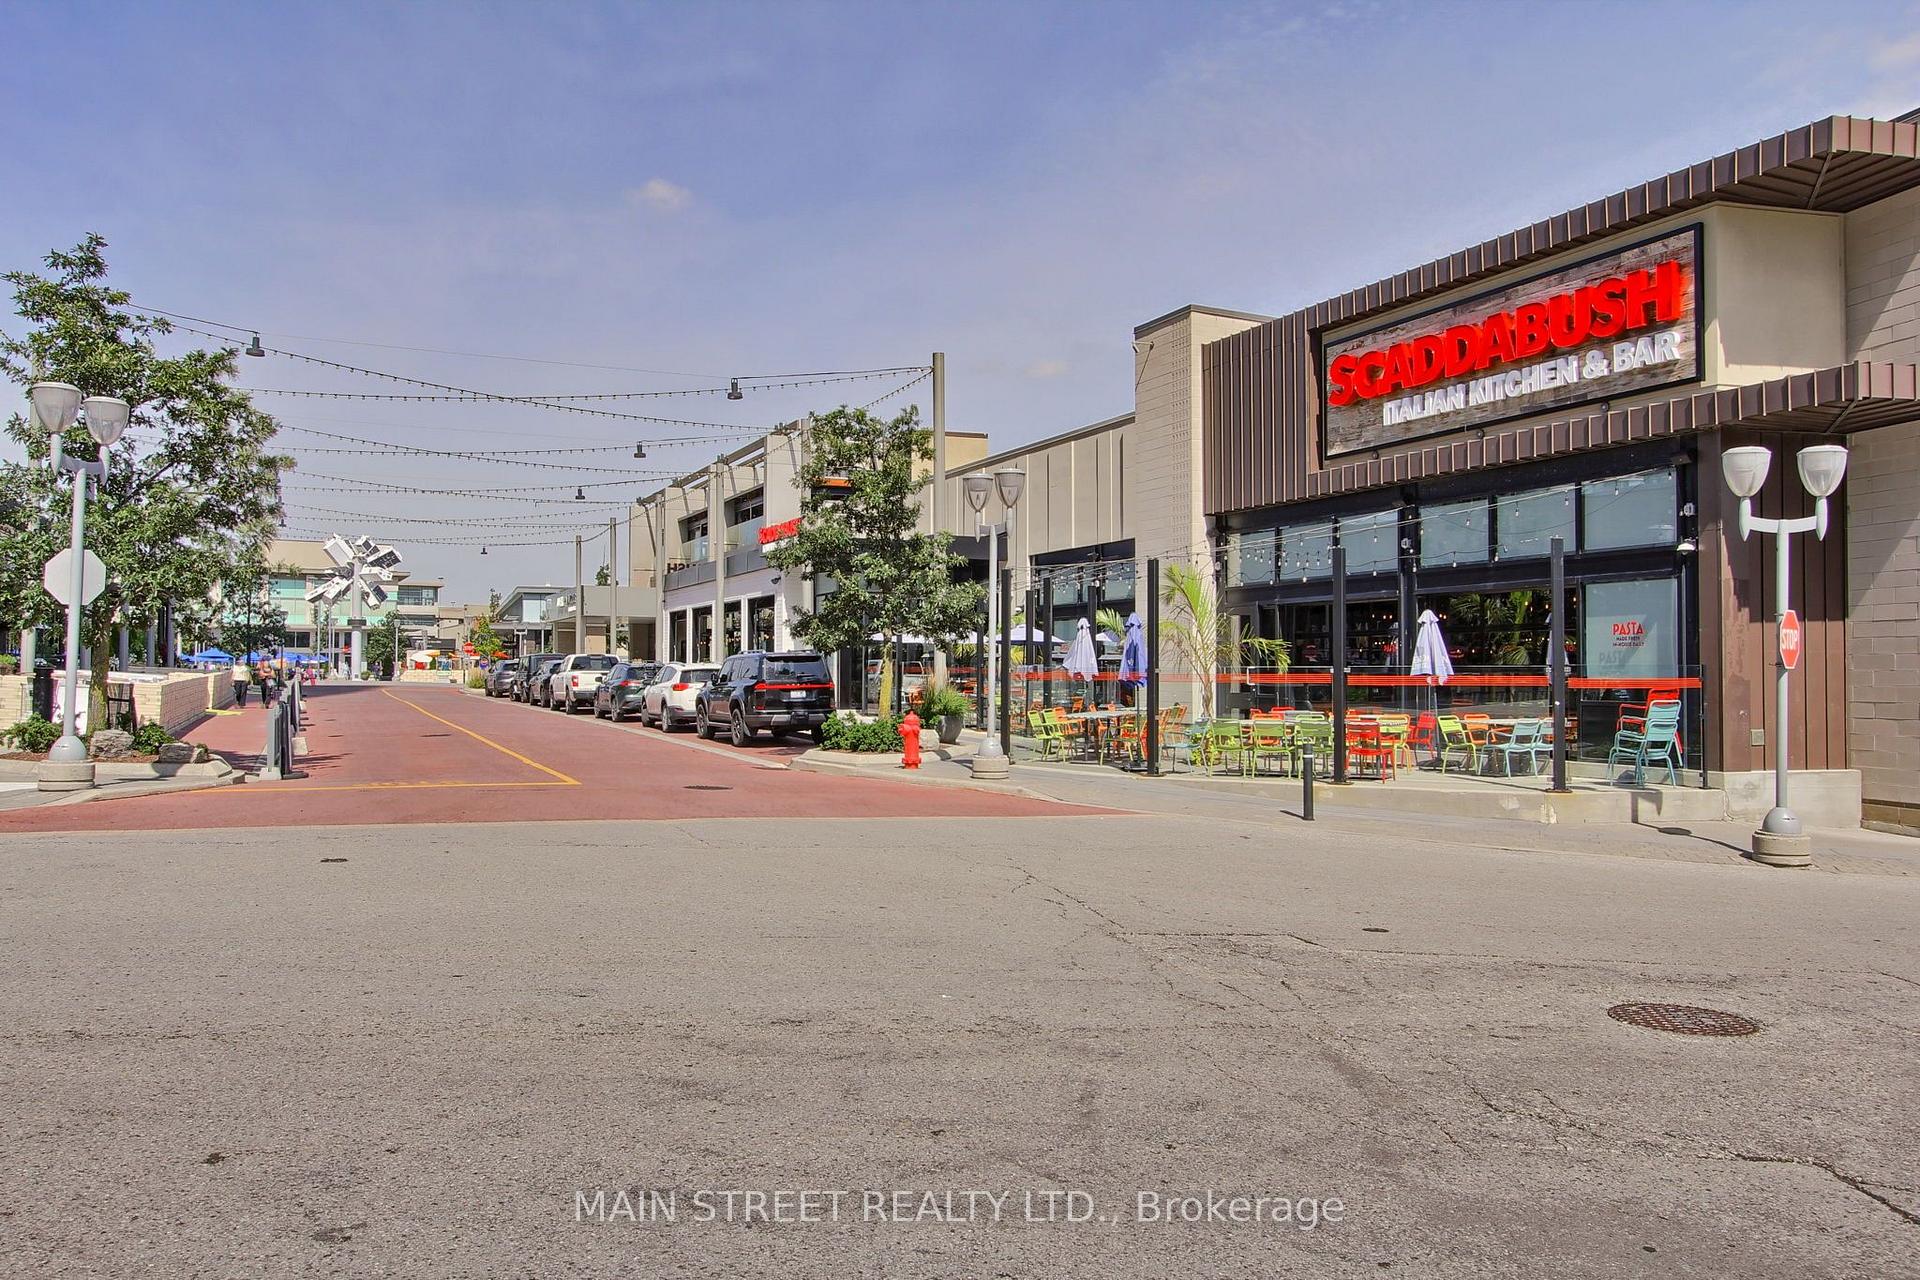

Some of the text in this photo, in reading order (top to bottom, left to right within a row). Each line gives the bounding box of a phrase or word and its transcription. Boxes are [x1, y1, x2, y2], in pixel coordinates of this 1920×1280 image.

[1328, 260, 1684, 407] SCADDABUSH
[1382, 331, 1682, 426] ITALIAN KITCHEN & BAR
[1613, 621, 1644, 635] PASTA
[1782, 629, 1798, 650] STOP
